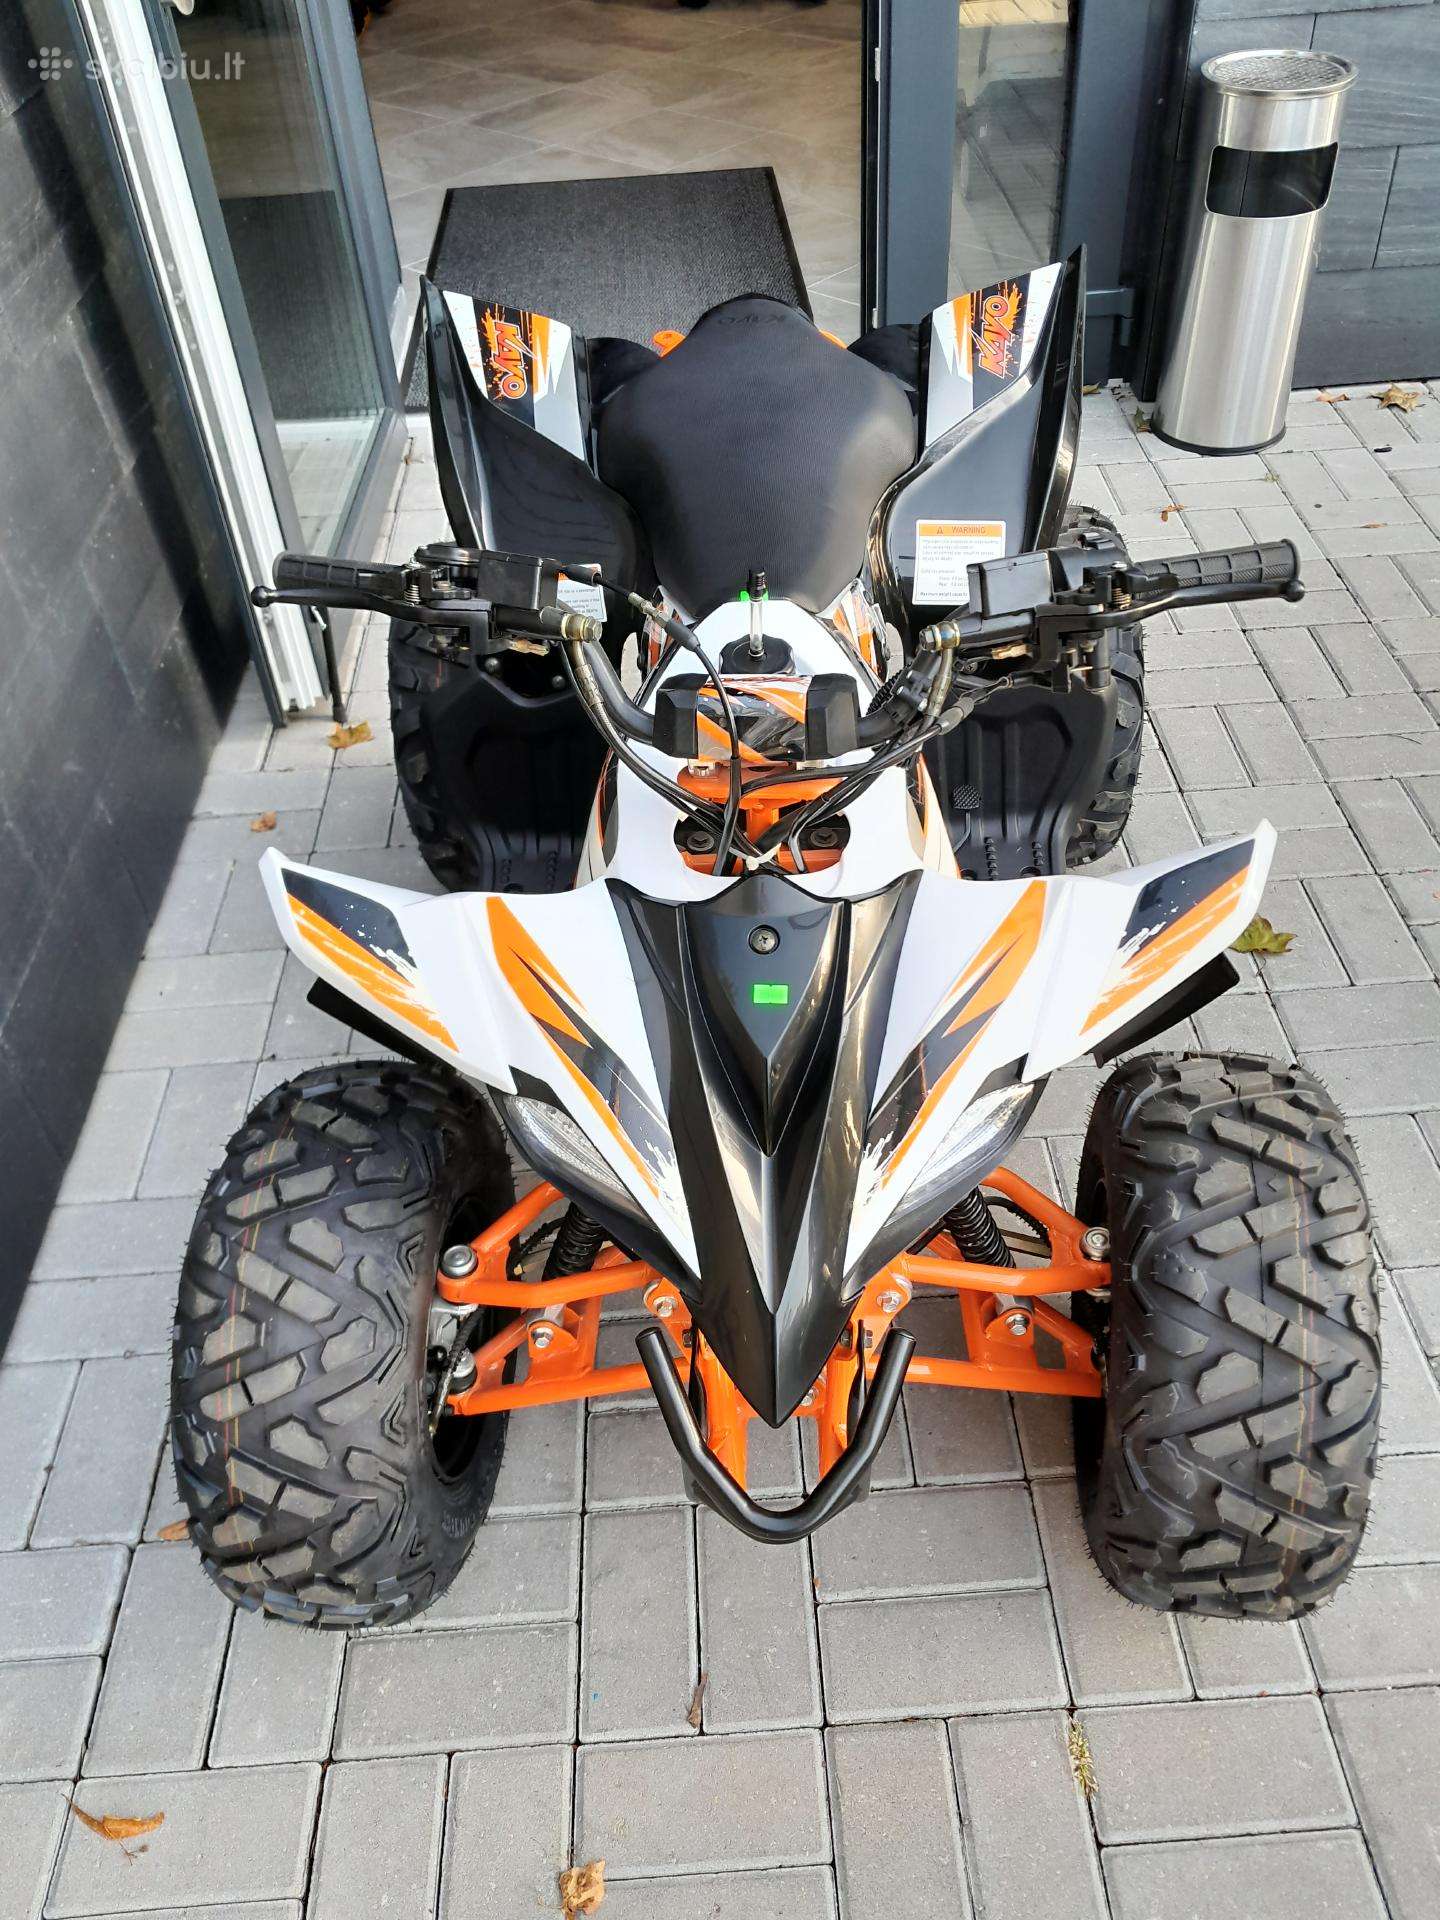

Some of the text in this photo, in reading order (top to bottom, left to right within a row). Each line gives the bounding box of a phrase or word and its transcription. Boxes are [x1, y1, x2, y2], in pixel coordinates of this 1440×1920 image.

[491, 319, 534, 400] KAYO
[972, 294, 1012, 379] KAYO
[951, 526, 986, 534] WARNING
